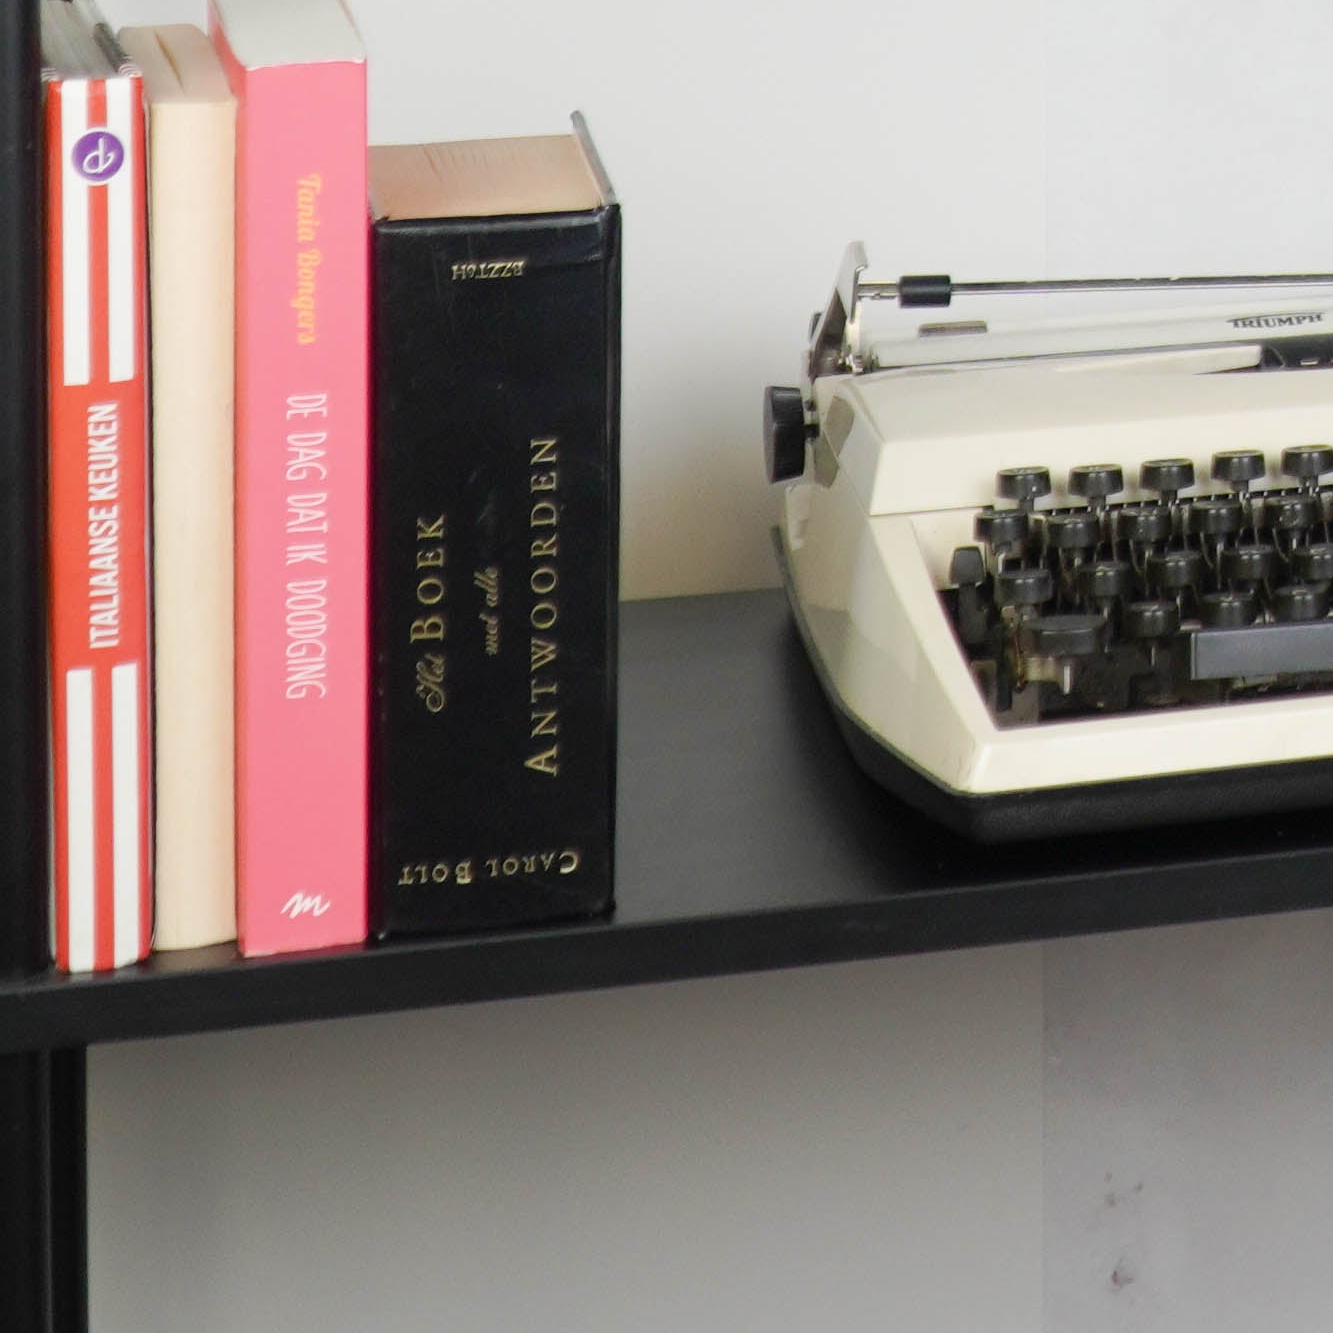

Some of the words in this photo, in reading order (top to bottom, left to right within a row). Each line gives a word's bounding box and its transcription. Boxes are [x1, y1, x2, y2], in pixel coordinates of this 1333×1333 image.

[297, 173, 323, 242] Tania
[290, 248, 321, 345] Bongers
[1226, 311, 1326, 329] TRIUMPH
[286, 393, 327, 420] DE
[87, 401, 118, 502] KEUKEN
[286, 431, 327, 481] DAG
[286, 492, 327, 533] DAT
[88, 504, 119, 649] ITALIAANSE
[286, 543, 327, 566] IK
[410, 514, 445, 644] BOEK
[473, 566, 499, 607] alle
[524, 437, 558, 777] ANTWOORDEN
[285, 579, 327, 699] DOODGING
[479, 612, 498, 656] met
[416, 652, 446, 713] Het
[398, 859, 472, 885] BOLT
[484, 850, 578, 878] CAROL
